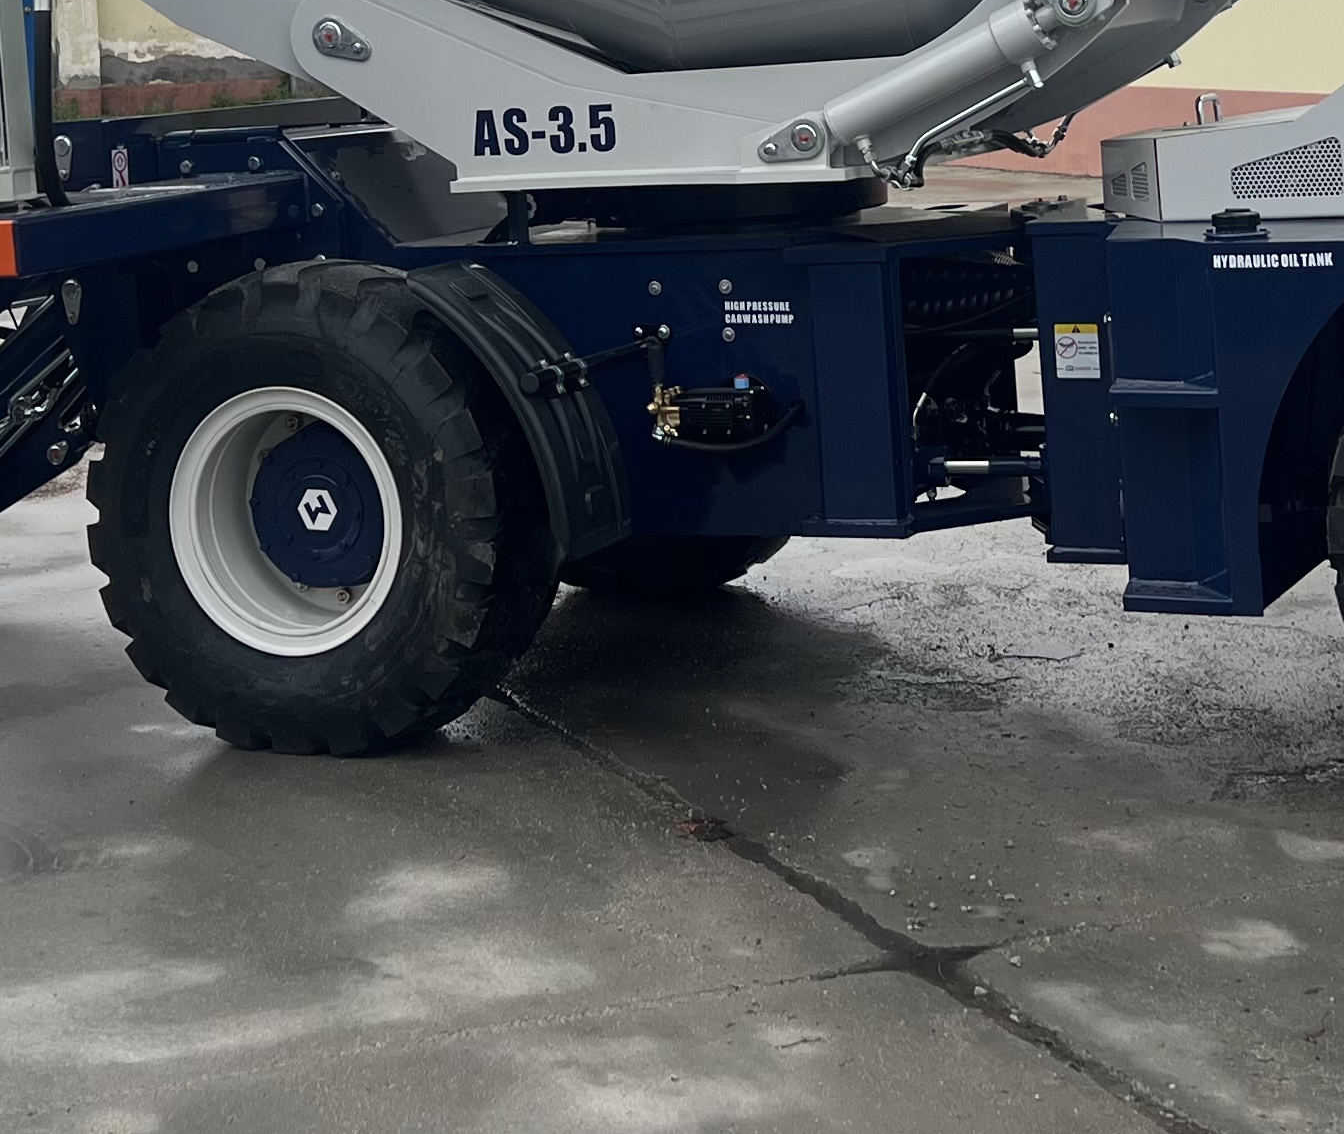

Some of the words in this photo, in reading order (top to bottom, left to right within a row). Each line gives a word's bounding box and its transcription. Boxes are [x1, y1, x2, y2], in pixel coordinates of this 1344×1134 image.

[474, 104, 616, 156] AS-3.5
[1213, 254, 1280, 269] HYDRAULIC
[1281, 253, 1299, 268] OIL
[1300, 252, 1333, 268] TANK
[724, 301, 745, 311] HIGH
[746, 301, 790, 312] PRESSURE
